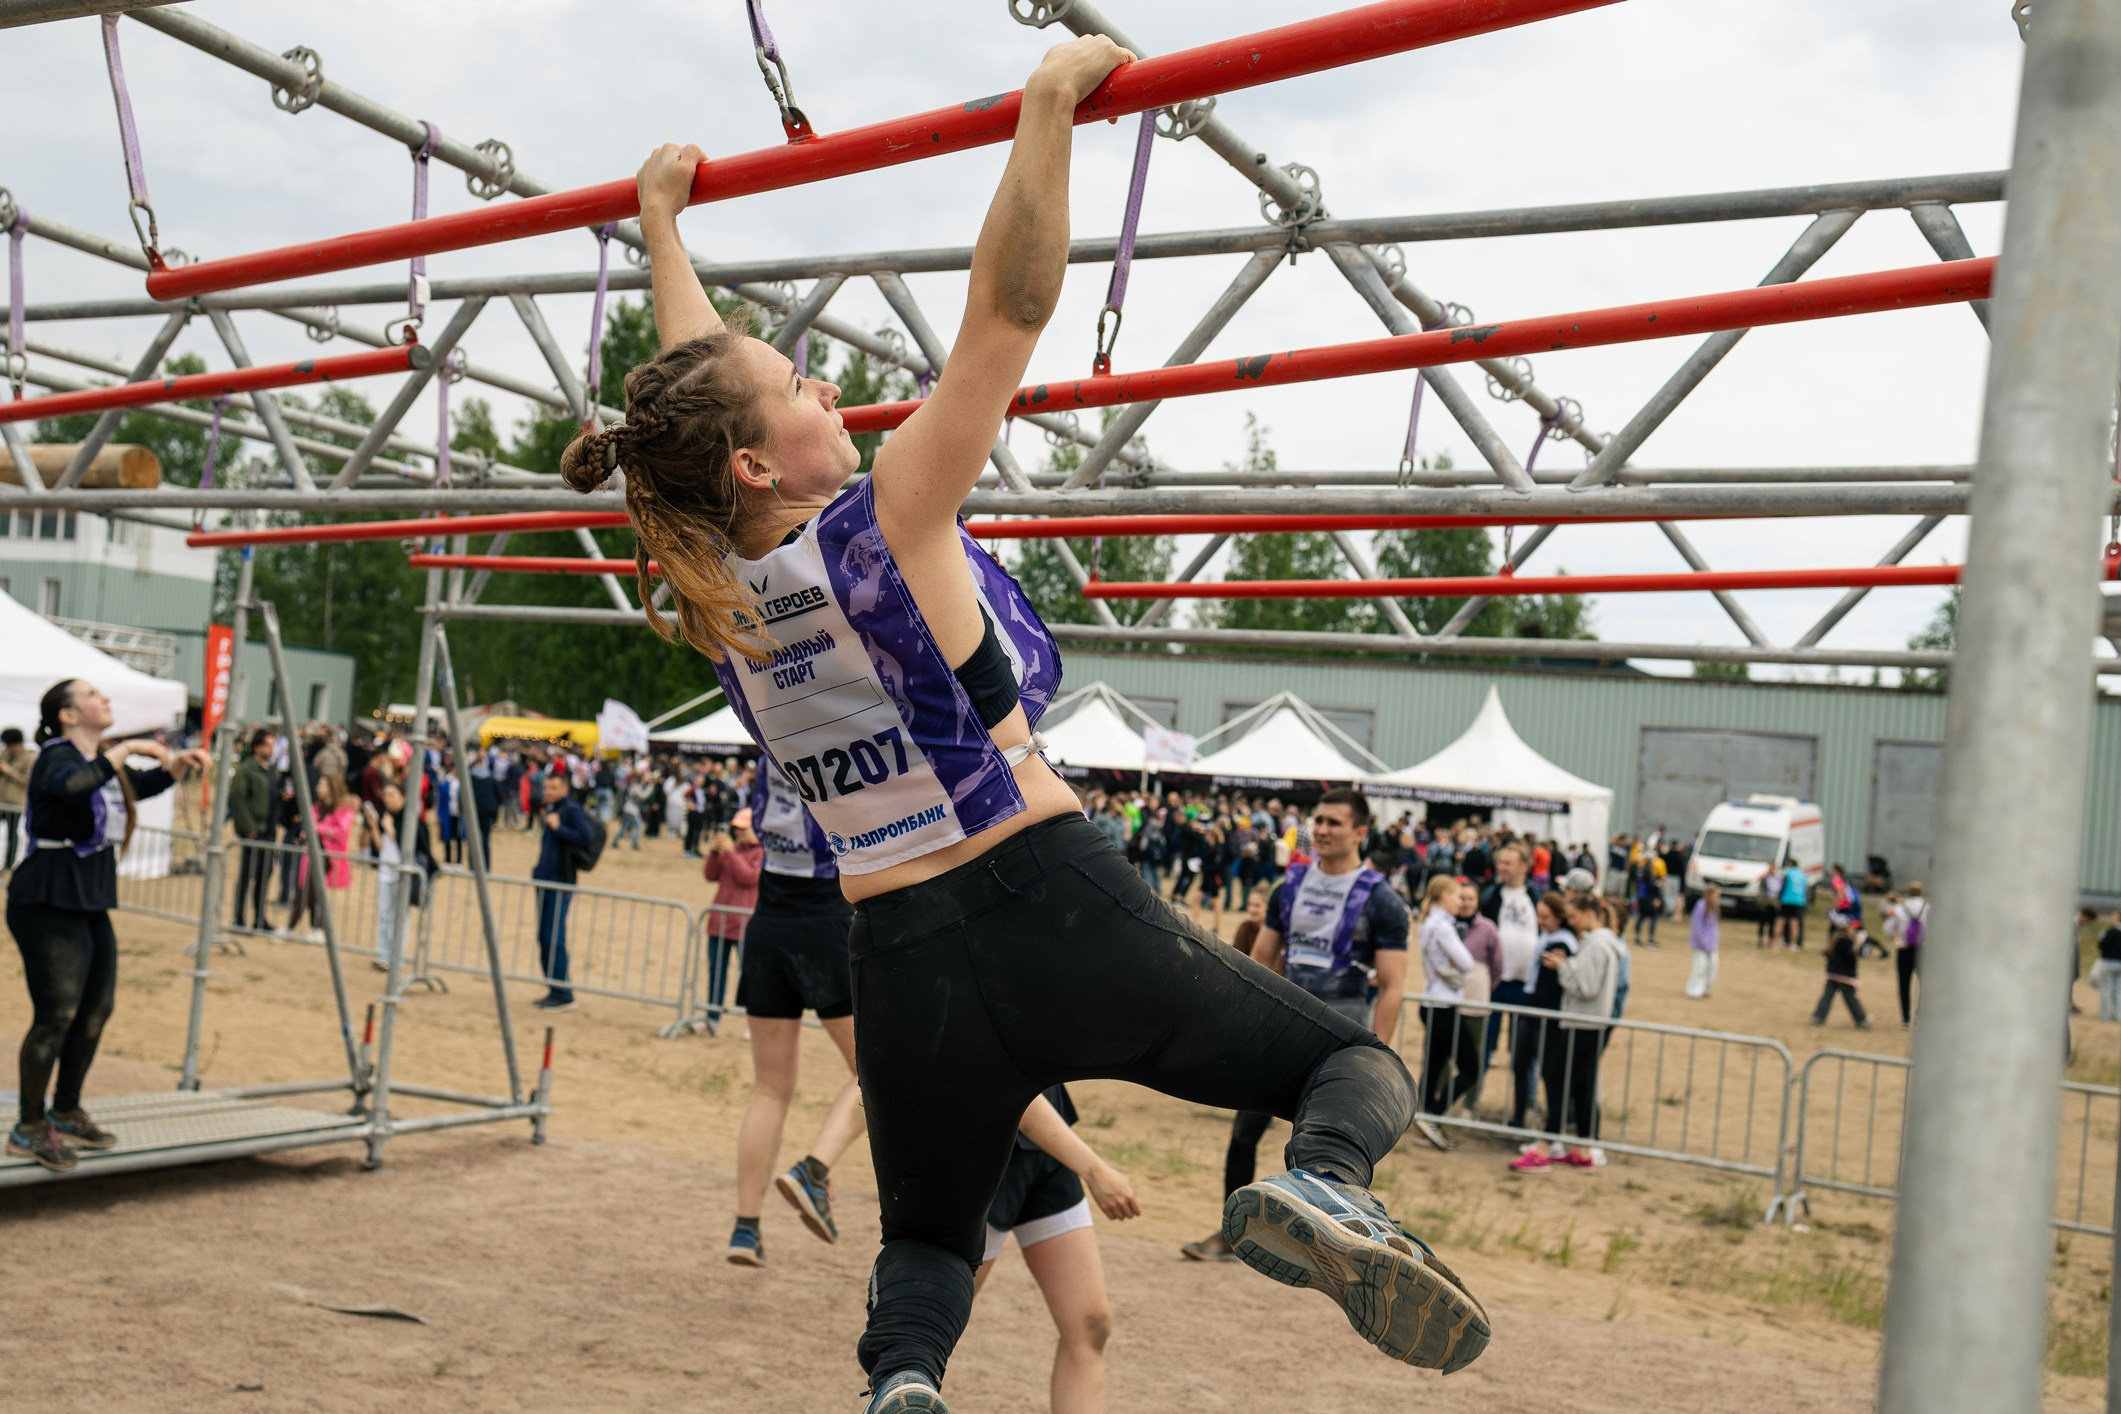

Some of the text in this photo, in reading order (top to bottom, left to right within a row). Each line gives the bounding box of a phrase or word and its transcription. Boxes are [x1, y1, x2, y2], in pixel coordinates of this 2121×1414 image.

[765, 585, 825, 617] ГЕРОЕВ
[772, 661, 816, 690] СТАРТ
[783, 726, 910, 803] 07207
[848, 803, 948, 850] ГАЗПРОМБАНК
